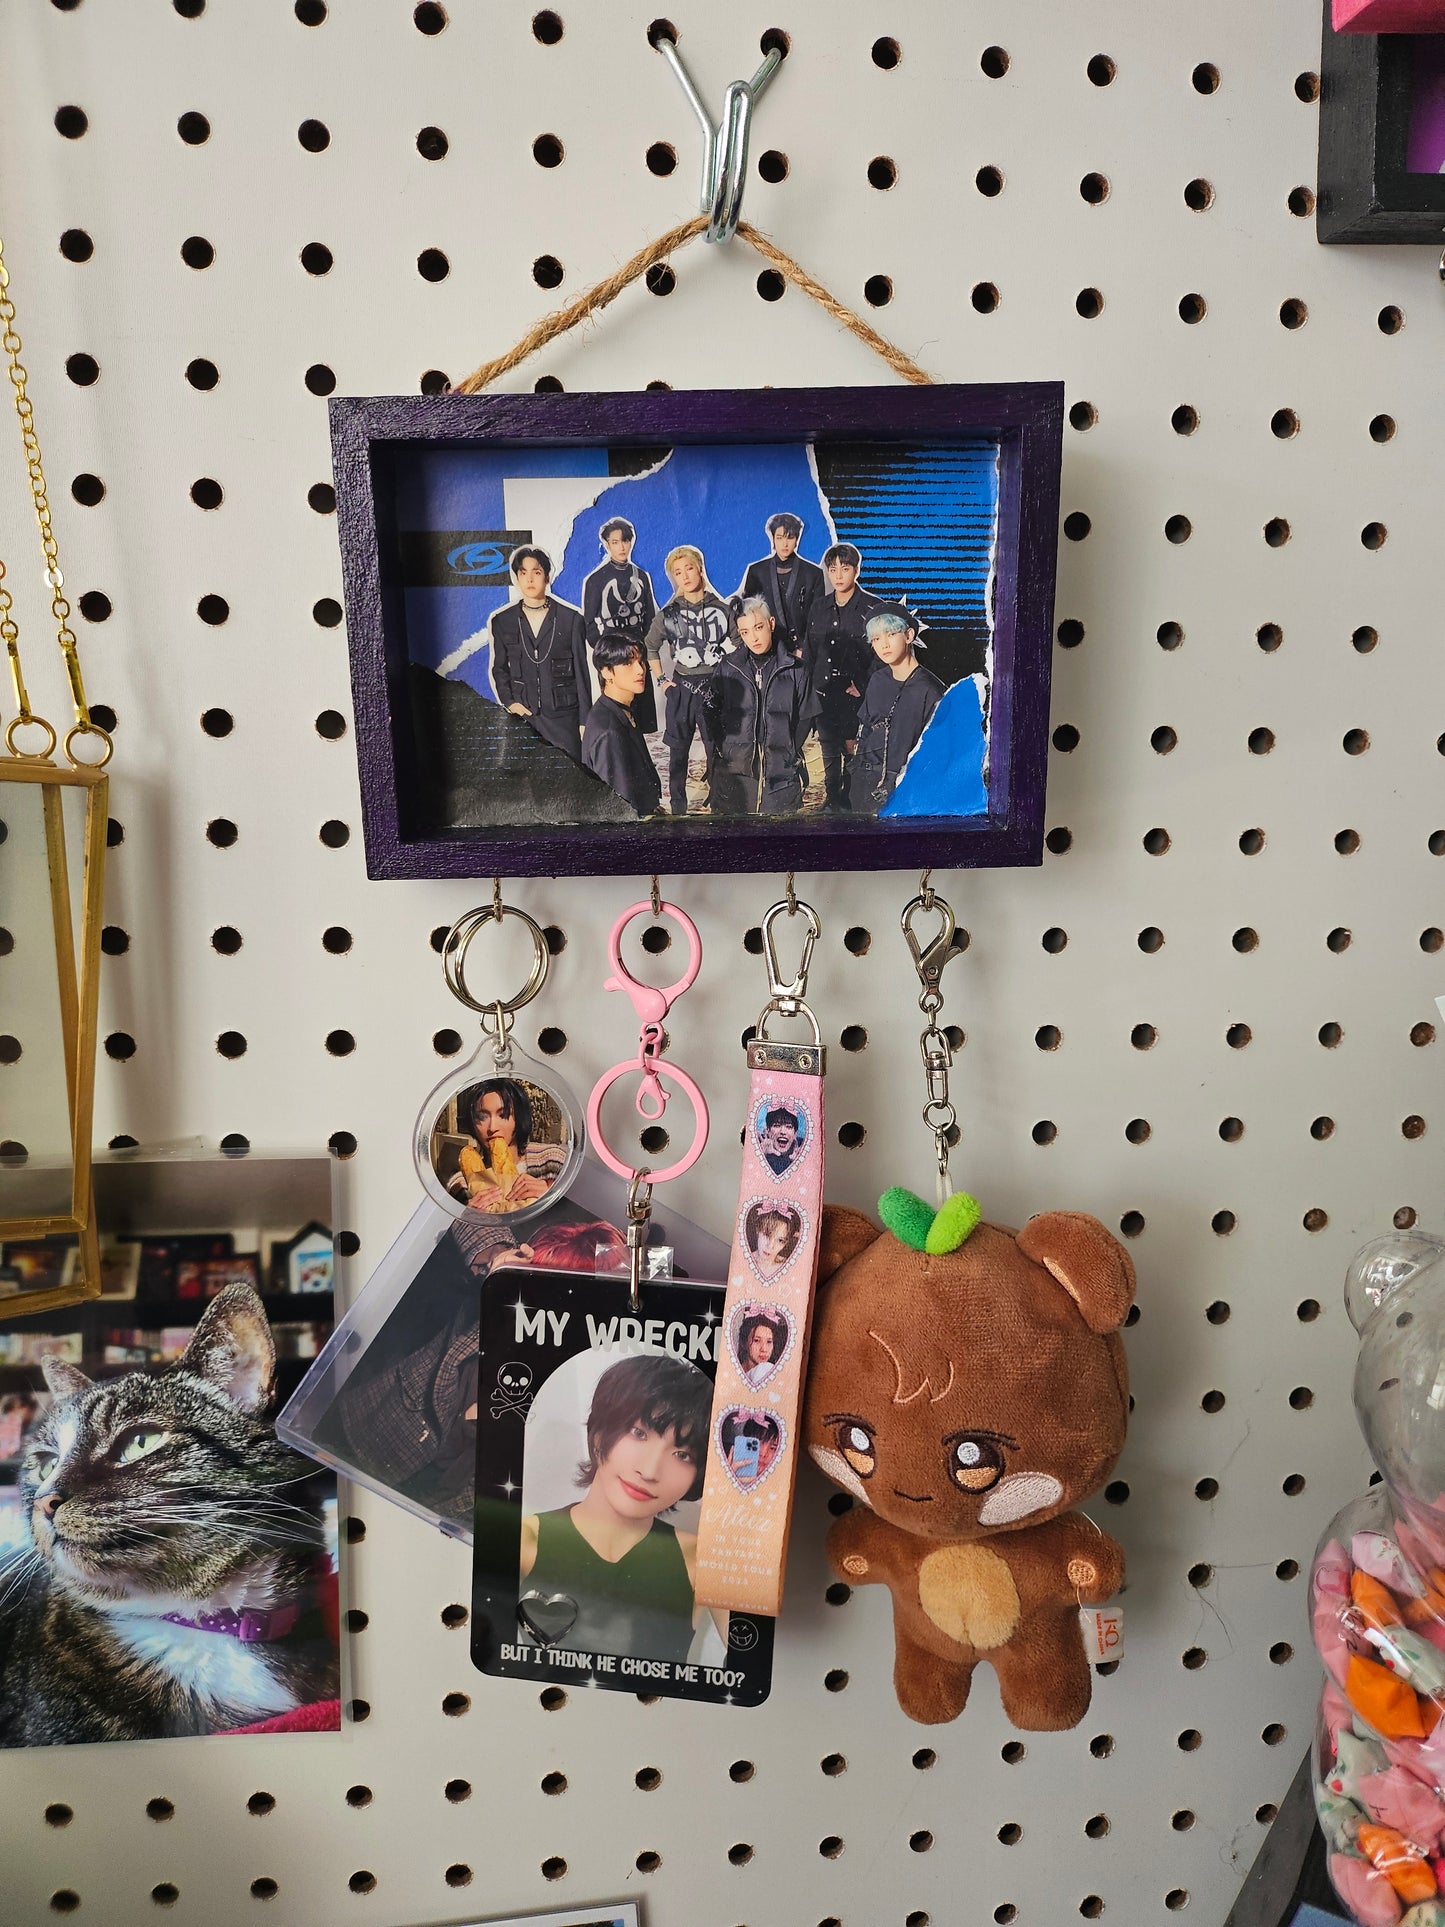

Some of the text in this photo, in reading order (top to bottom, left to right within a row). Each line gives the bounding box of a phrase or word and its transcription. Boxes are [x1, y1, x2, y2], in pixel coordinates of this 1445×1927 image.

[514, 1309, 570, 1347] MY
[699, 1560, 773, 1576] WORLD TOUR
[501, 1643, 746, 1688] BUT I THINK HE CHOSE ME TOO?
